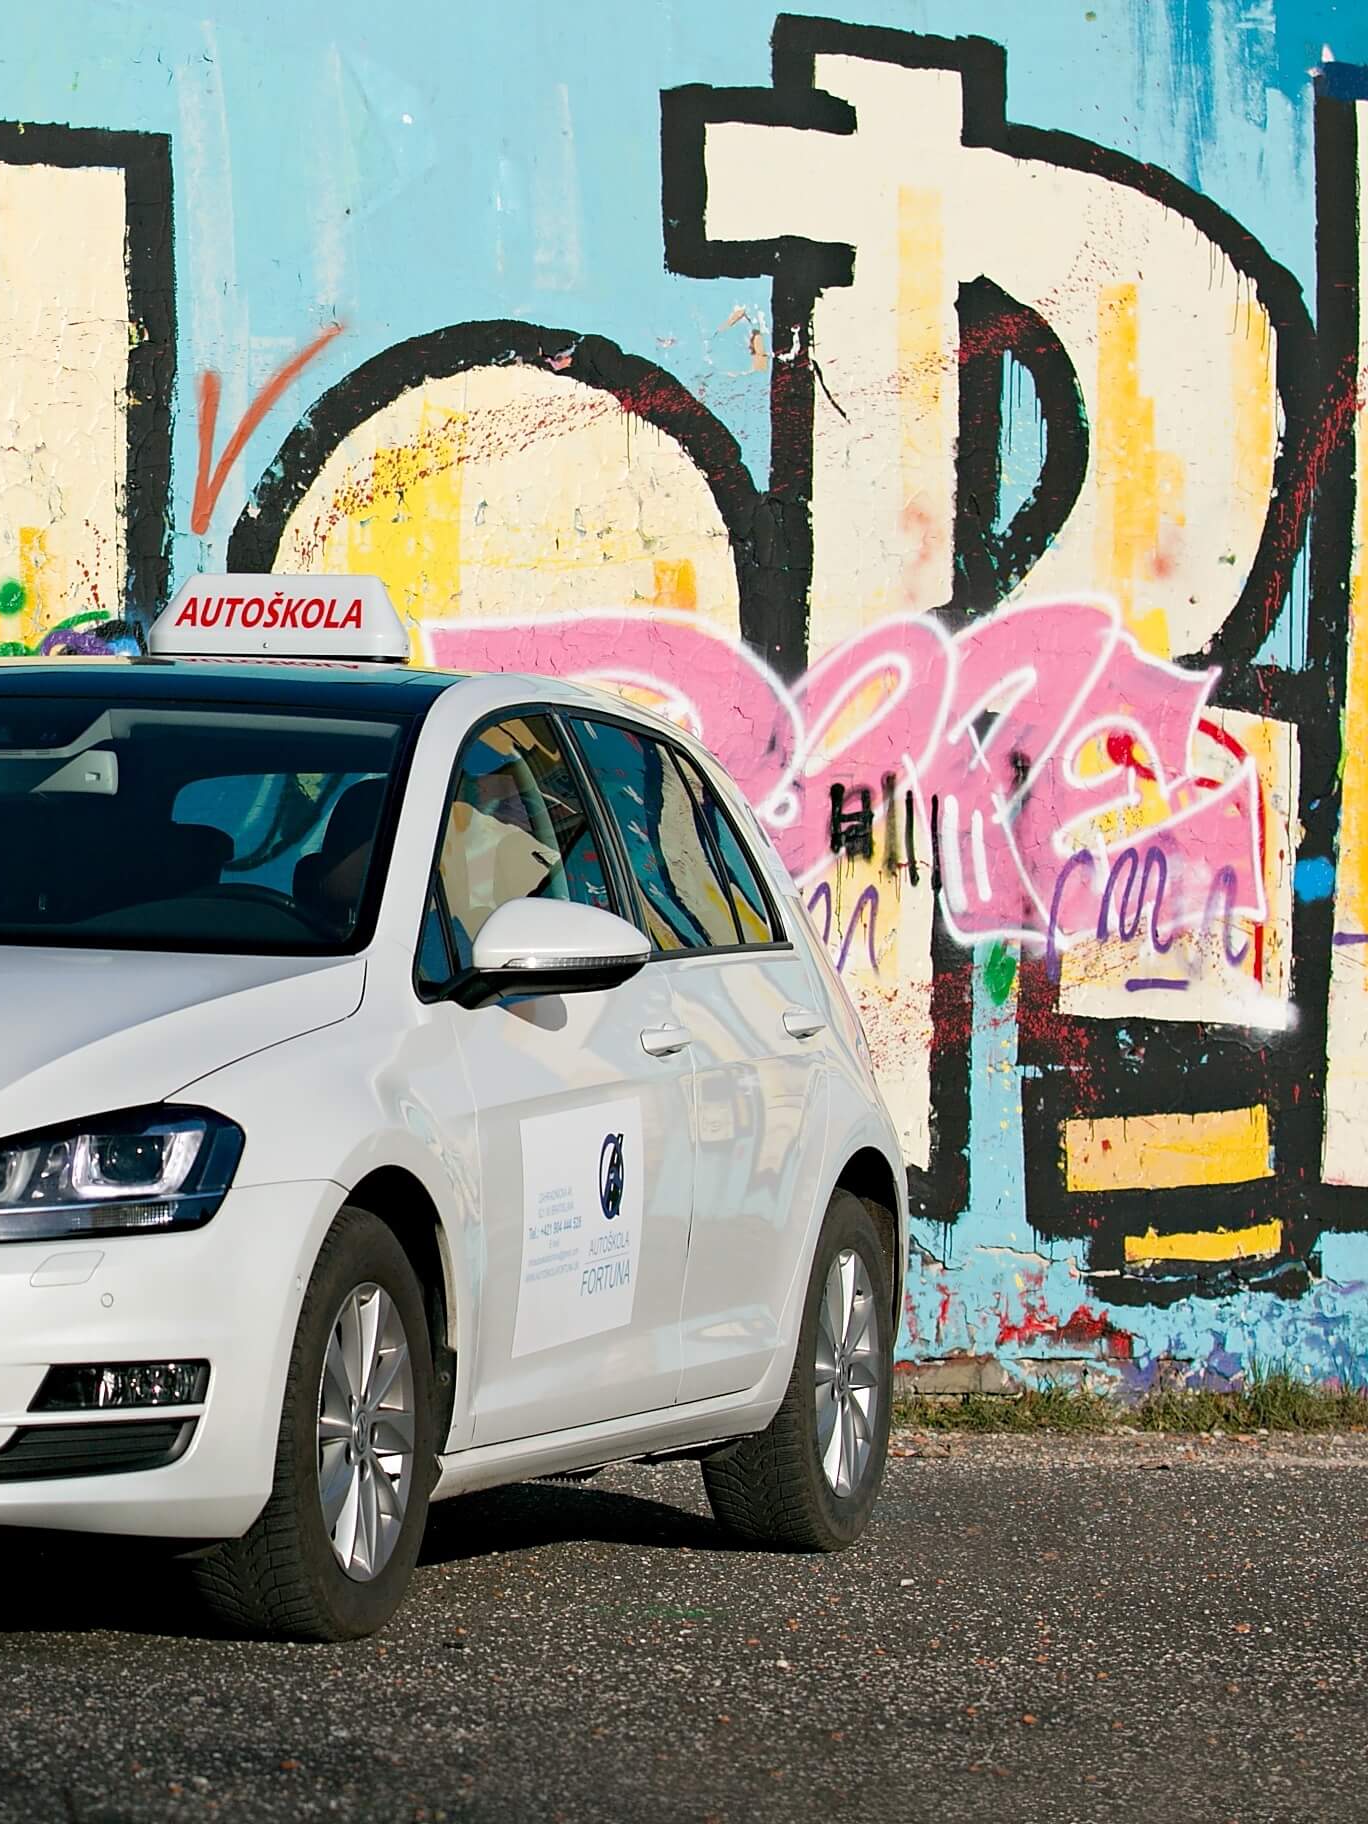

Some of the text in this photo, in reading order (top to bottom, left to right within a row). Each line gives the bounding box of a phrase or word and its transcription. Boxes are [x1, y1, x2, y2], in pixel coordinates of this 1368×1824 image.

[174, 591, 363, 630] AUTOŠKOLA
[588, 1230, 630, 1256] AUTOŠKOLA
[580, 1260, 630, 1297] FORTUNA
